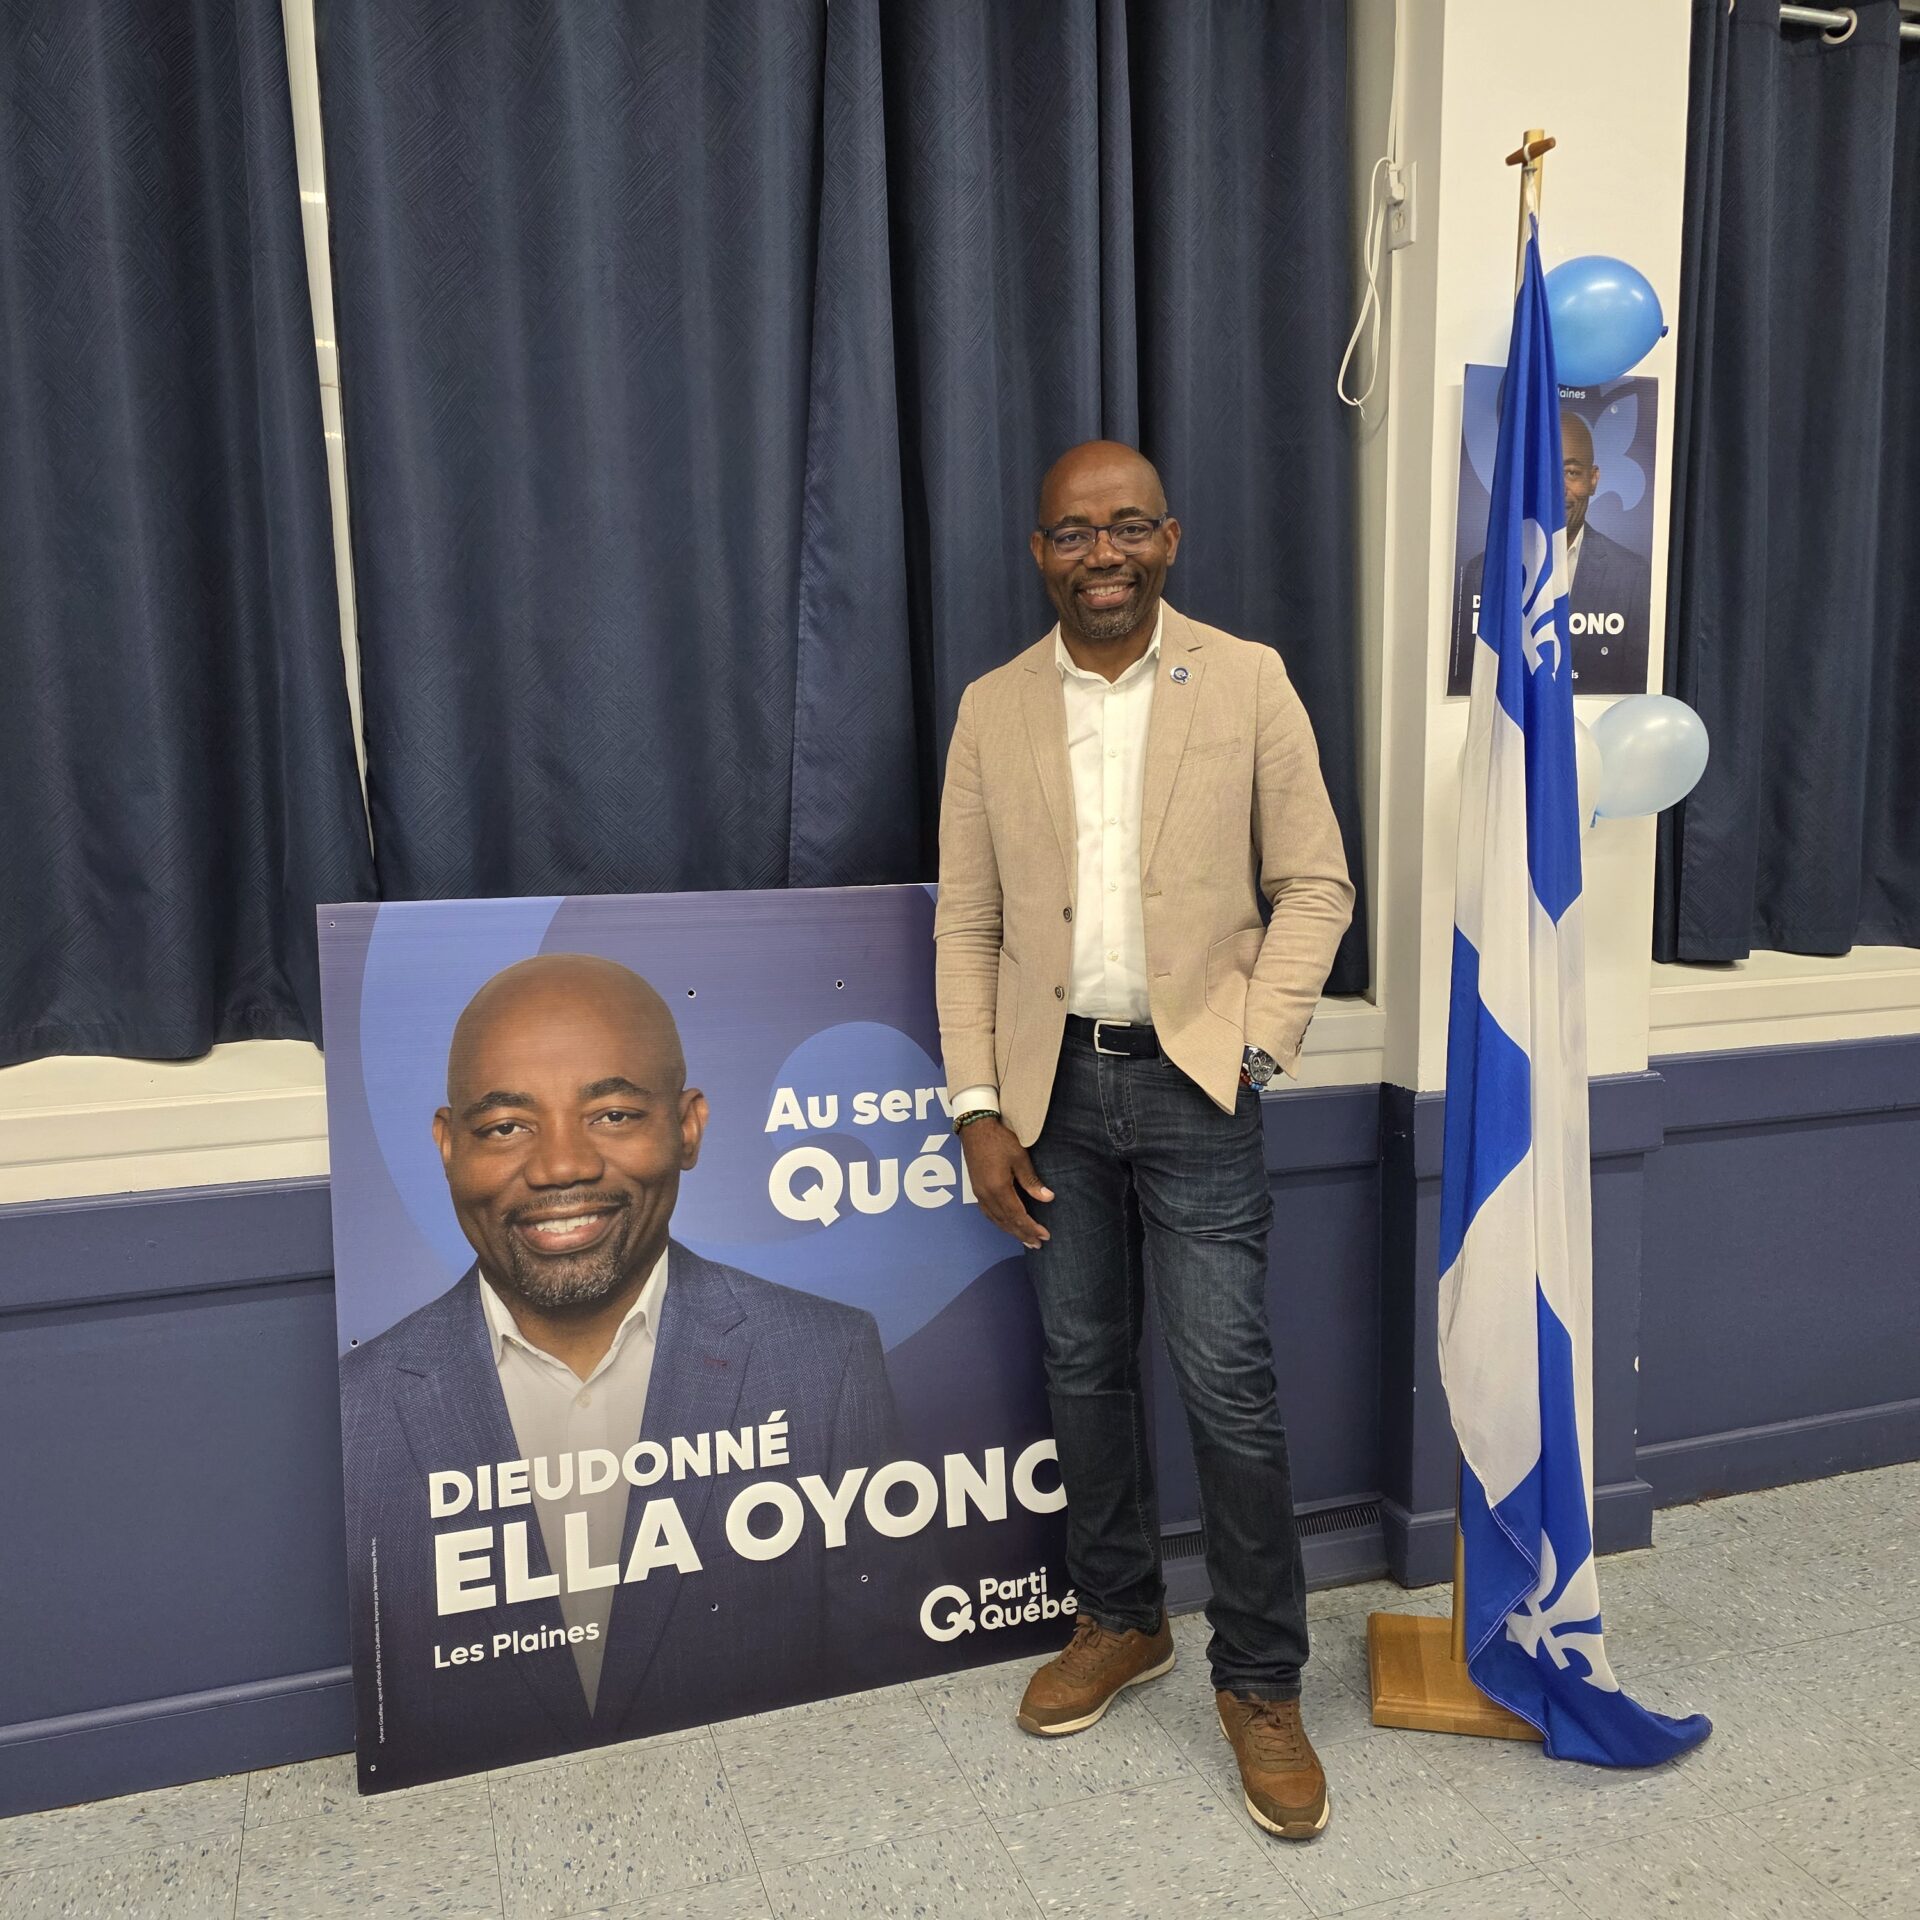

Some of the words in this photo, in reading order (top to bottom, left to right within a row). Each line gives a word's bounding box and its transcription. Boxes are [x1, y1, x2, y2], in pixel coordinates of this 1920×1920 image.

[1557, 387, 1586, 399] laines
[1569, 612, 1625, 635] ONO
[764, 1087, 839, 1133] Au
[428, 1409, 790, 1519] DIEUDONNÉ
[434, 1497, 704, 1616] ELLA
[979, 1566, 1048, 1604] Parti
[980, 1589, 1079, 1631] Québé
[433, 1629, 485, 1669] Les
[492, 1622, 600, 1658] Plaines
